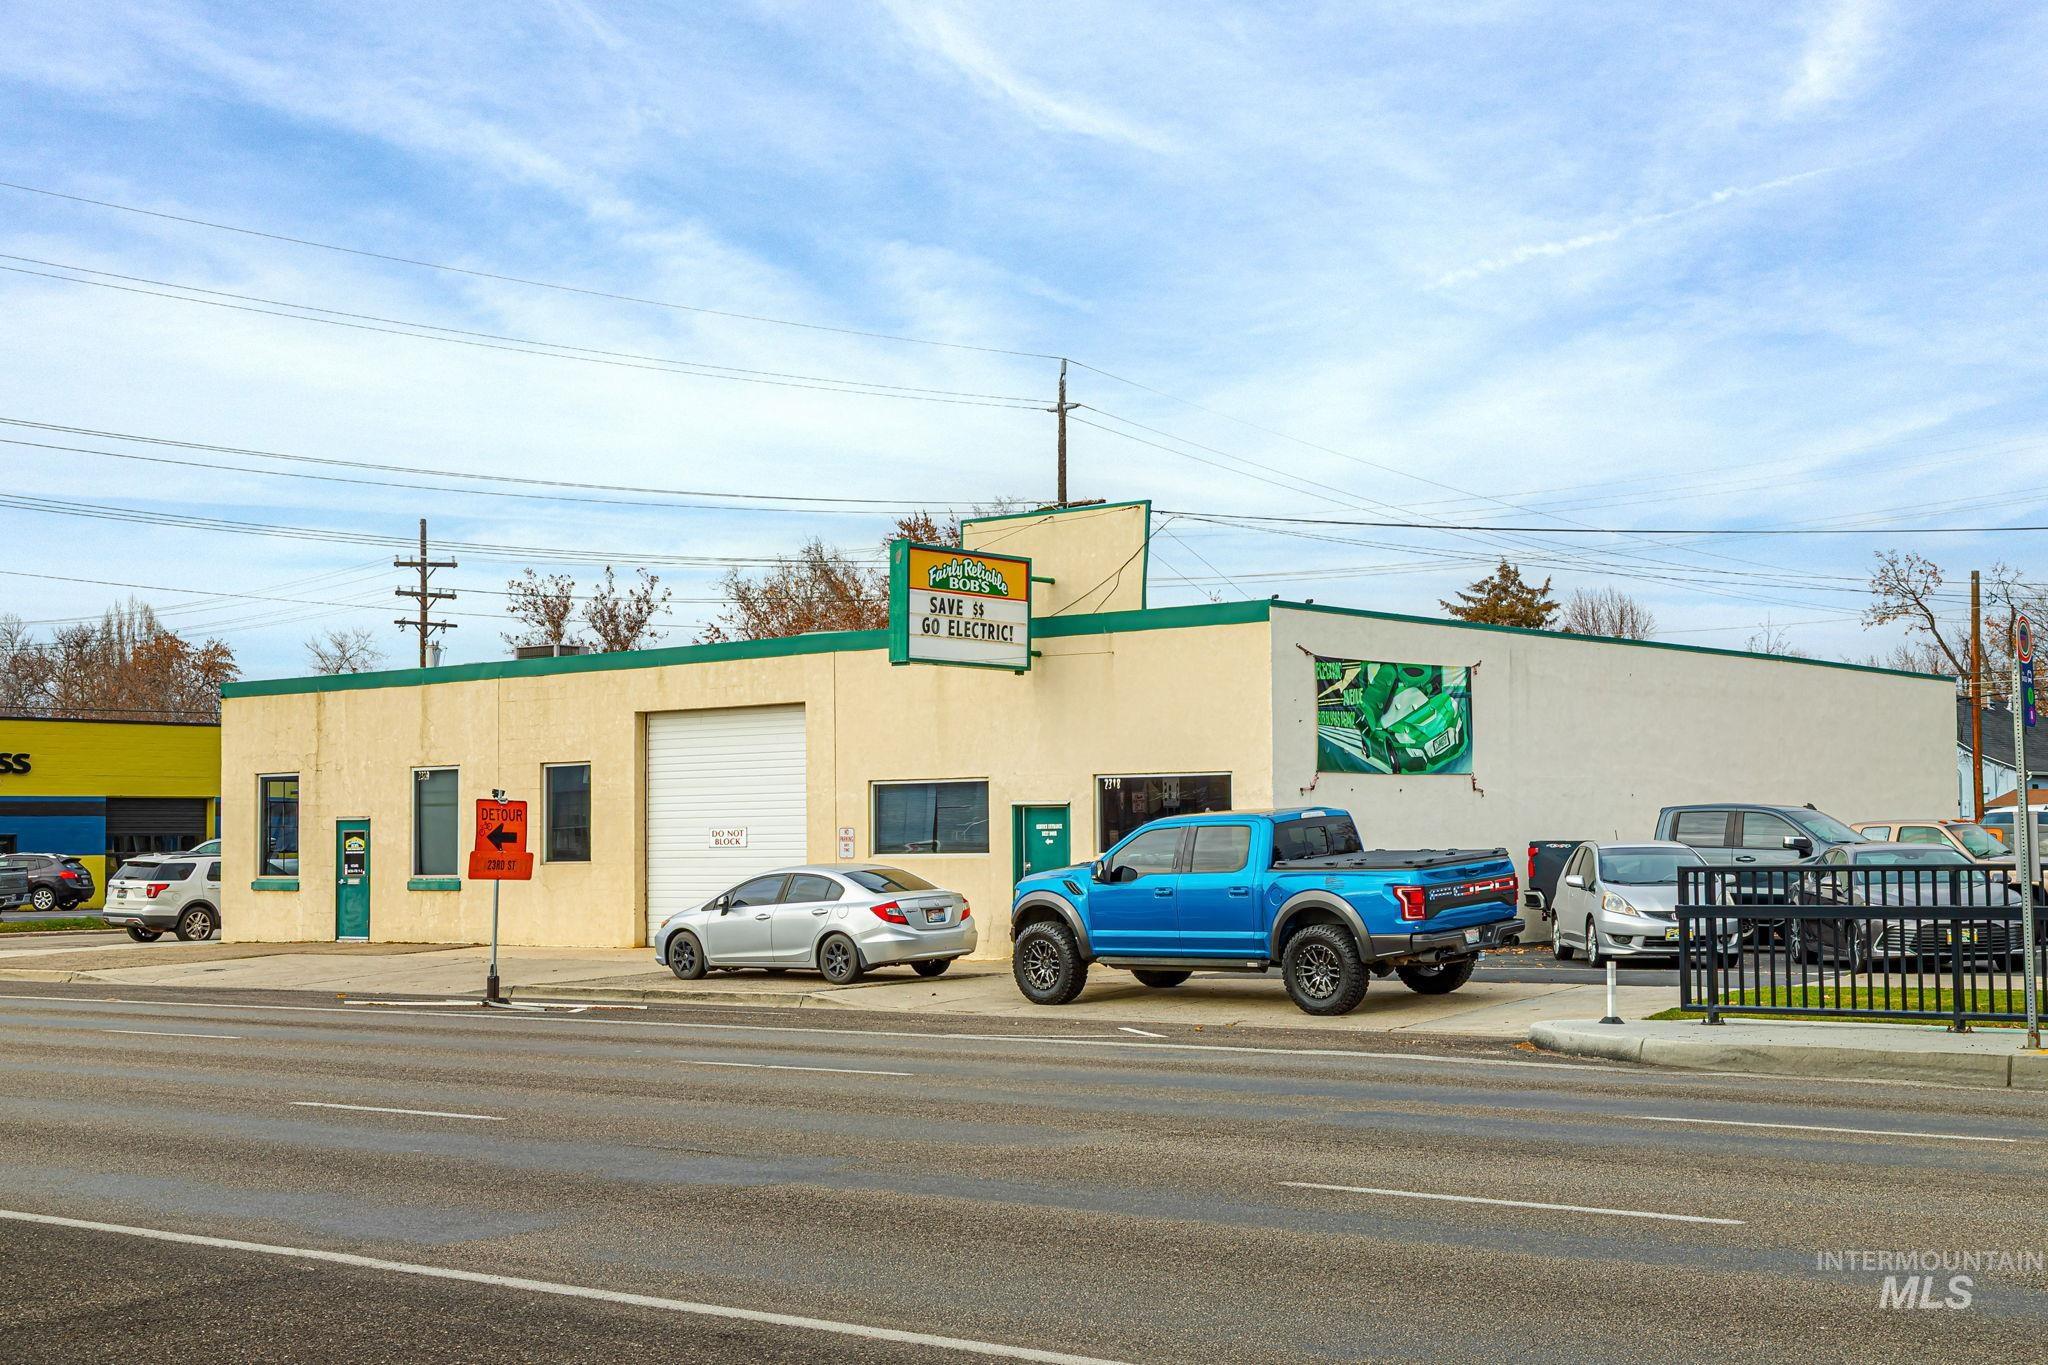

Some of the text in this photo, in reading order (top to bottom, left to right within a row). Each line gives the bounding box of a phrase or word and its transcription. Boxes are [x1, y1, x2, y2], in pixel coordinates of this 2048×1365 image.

[929, 559, 1008, 595] Fairly Reliable
[949, 577, 990, 593] BOB'S
[930, 597, 985, 618] SAVE $$
[922, 617, 1014, 642] GO ELECTRIC!
[481, 808, 523, 822] DETOUR
[711, 829, 744, 838] DO NOT
[714, 838, 741, 846] BLOCK
[487, 860, 516, 871] 23RD ST
[1429, 877, 1515, 901] FORD
